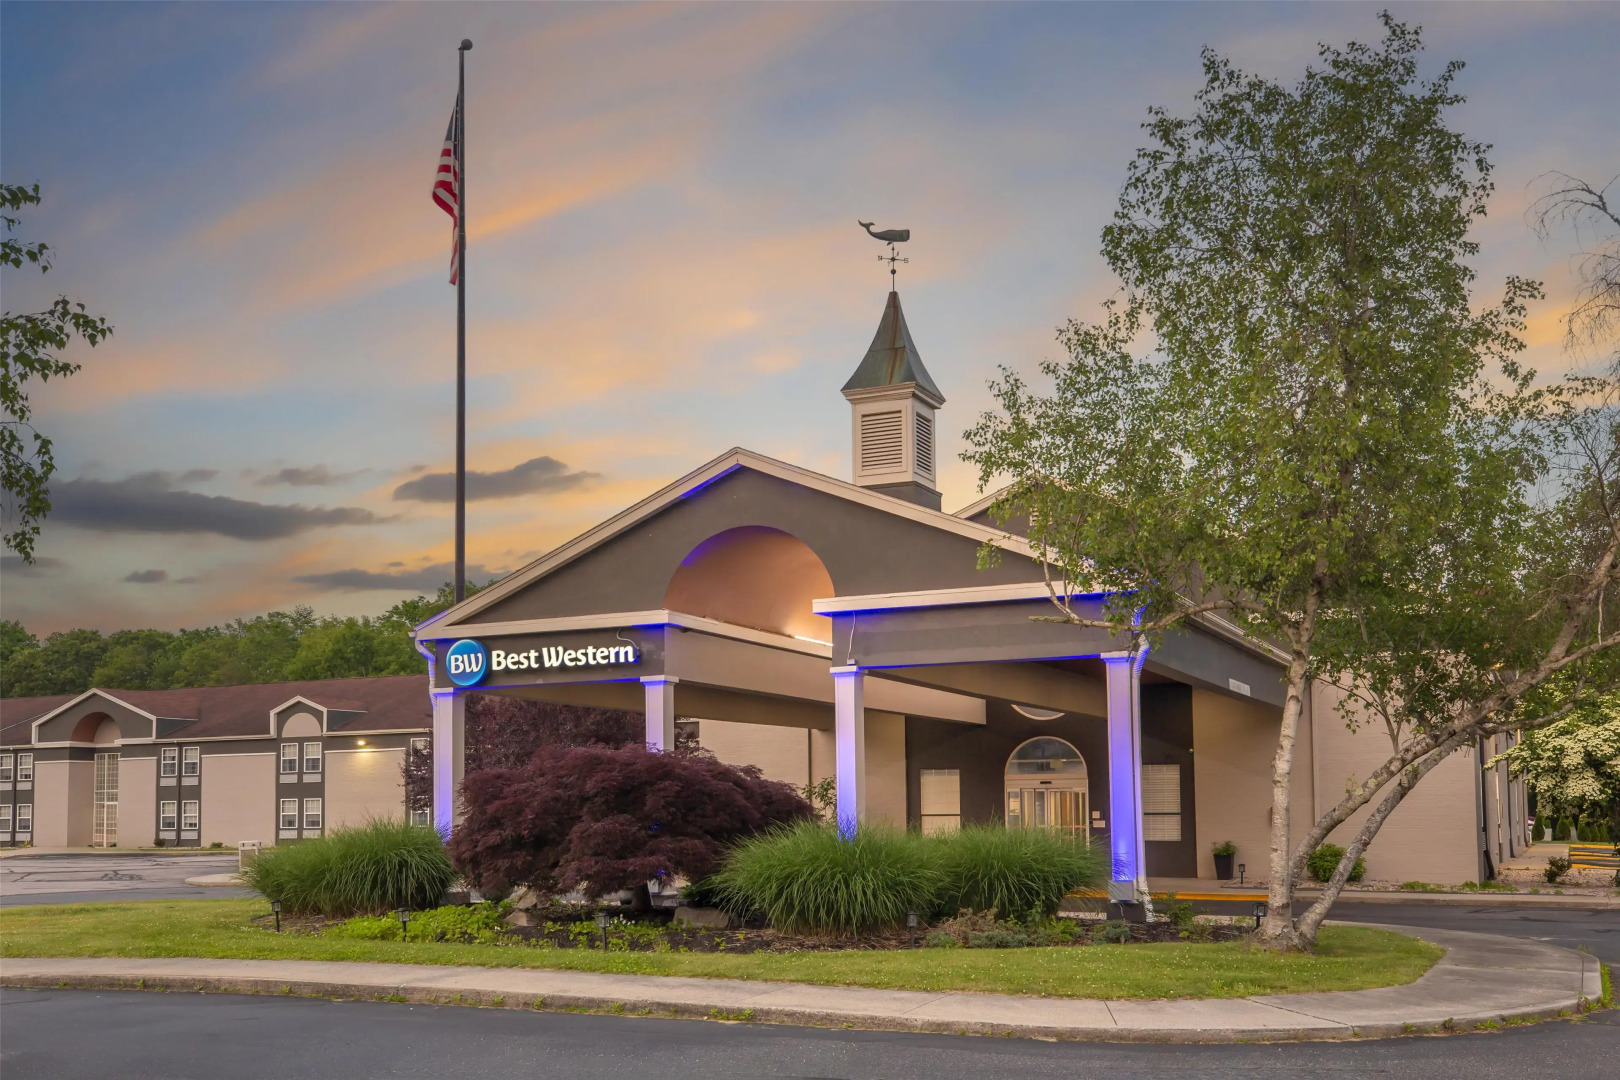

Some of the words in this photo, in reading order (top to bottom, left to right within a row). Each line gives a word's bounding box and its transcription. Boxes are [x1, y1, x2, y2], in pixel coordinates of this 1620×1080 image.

[450, 652, 483, 674] BW
[491, 649, 539, 671] Best
[541, 645, 635, 667] Western
